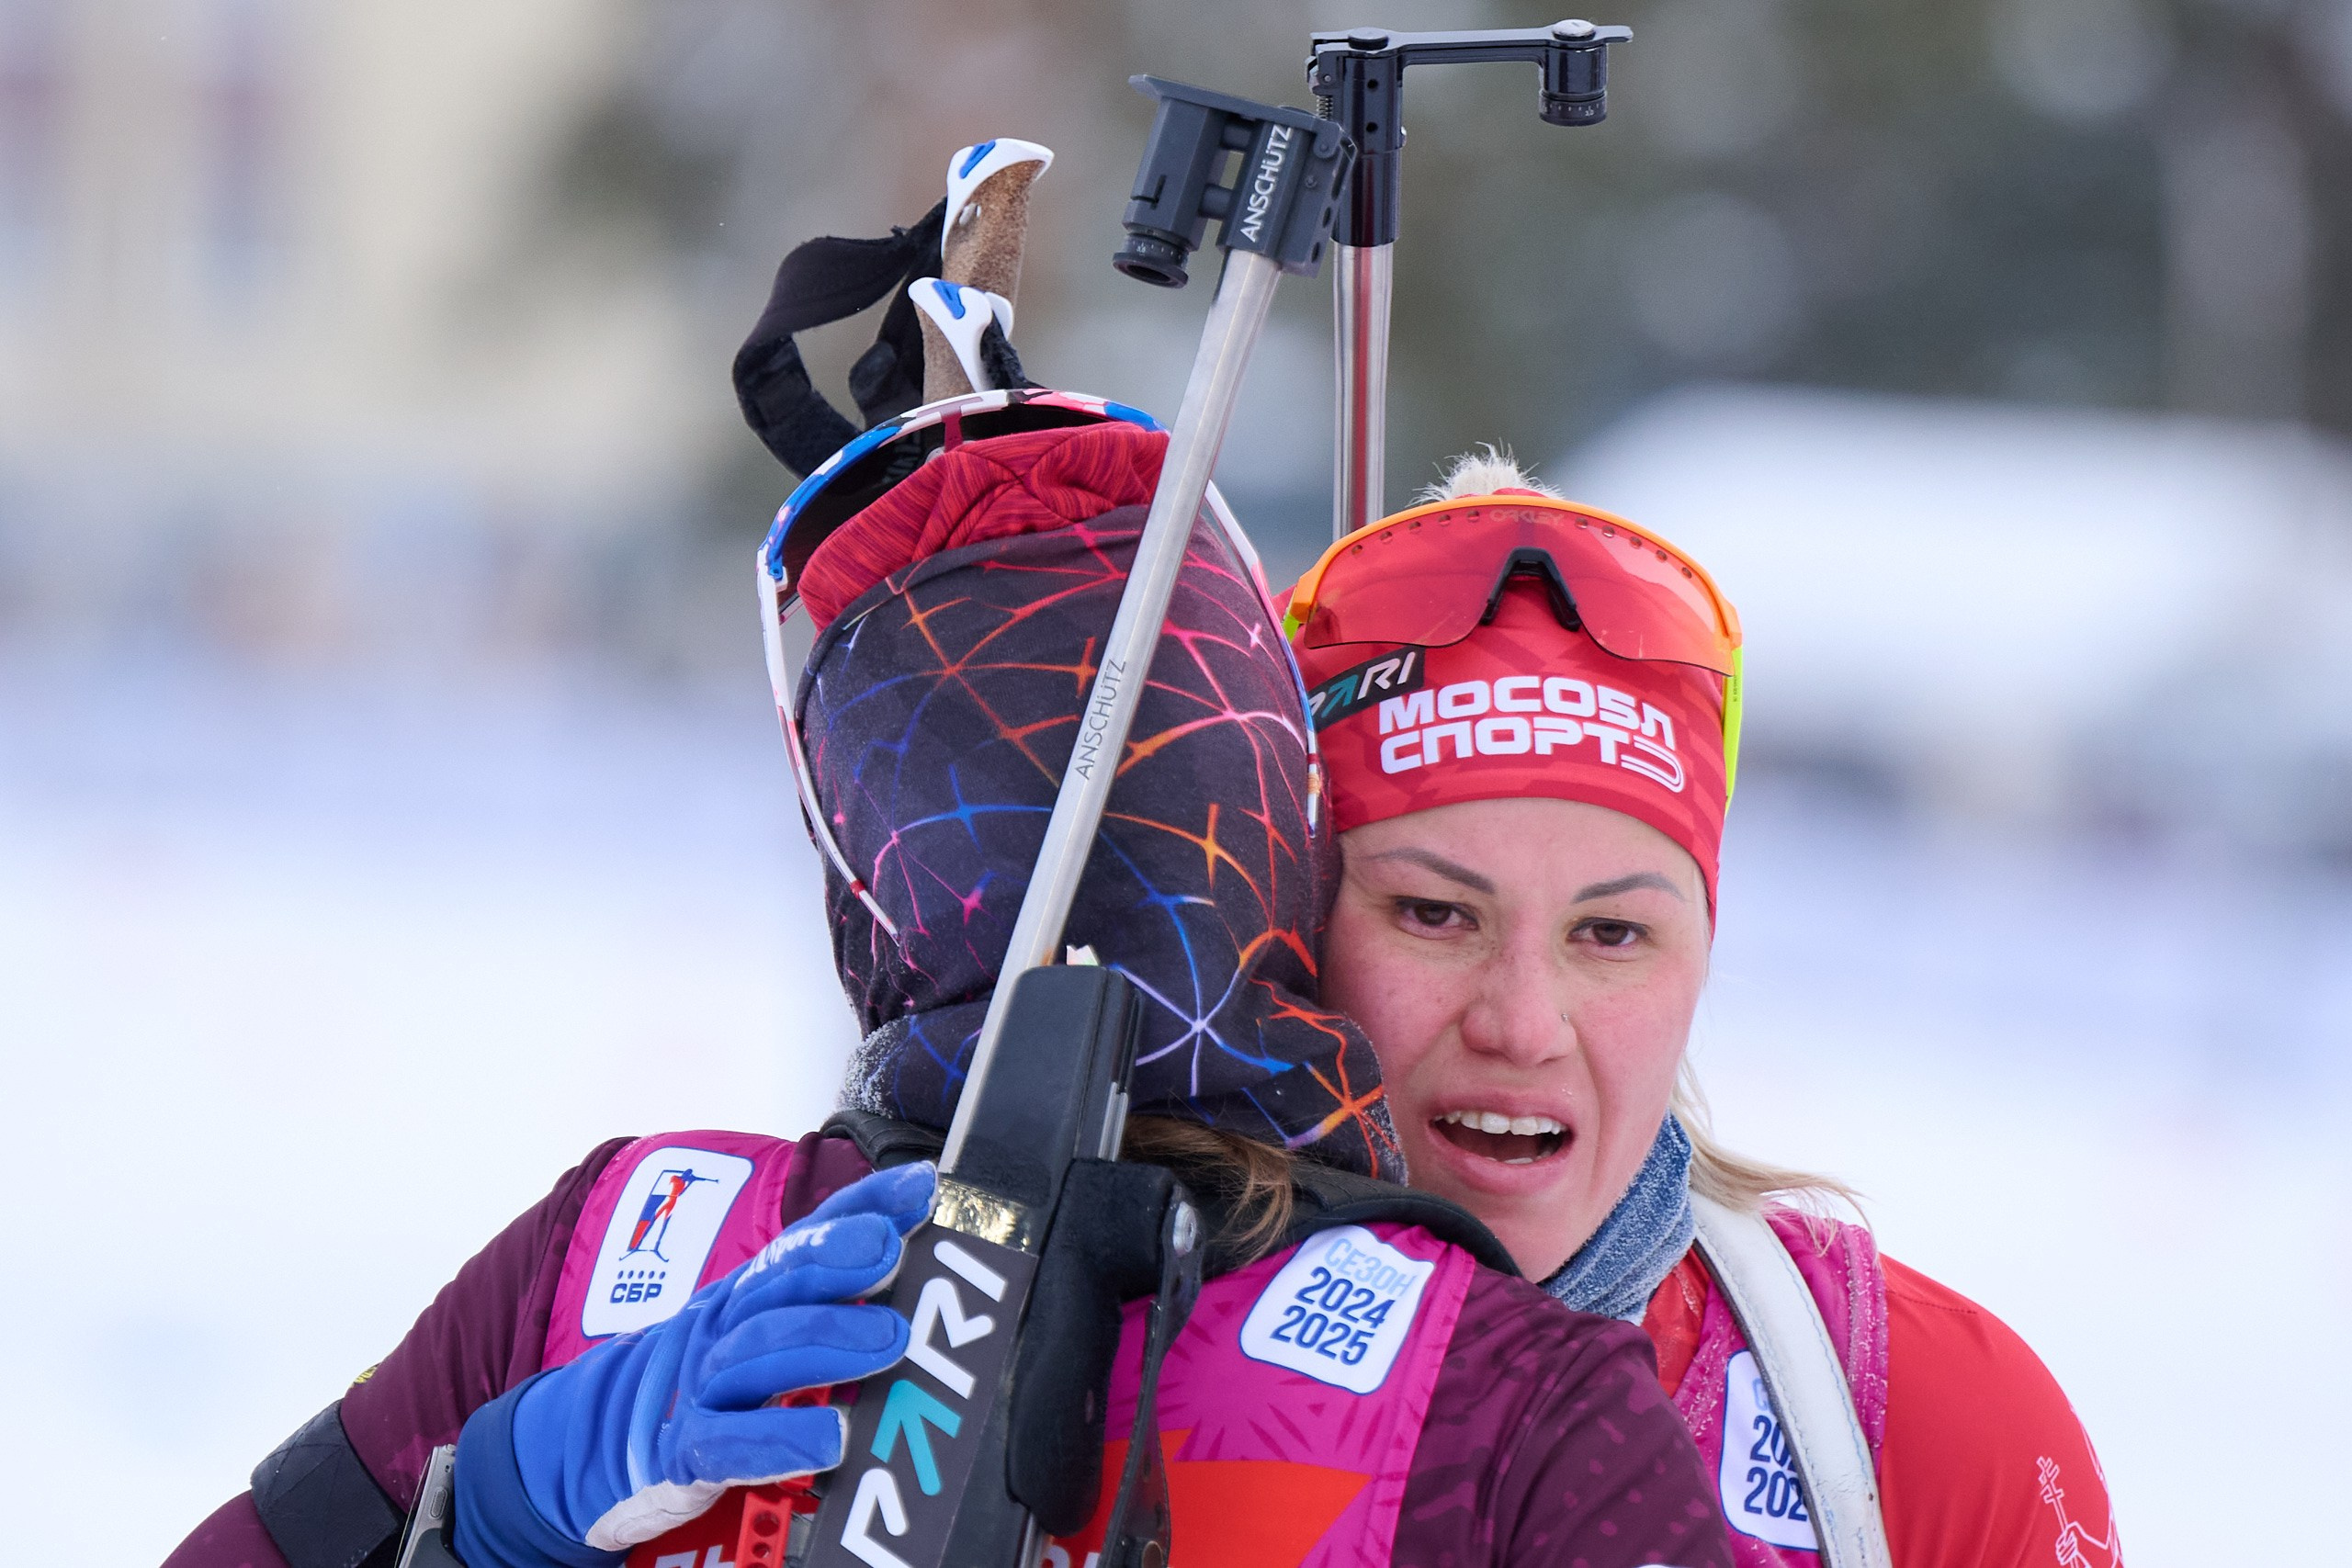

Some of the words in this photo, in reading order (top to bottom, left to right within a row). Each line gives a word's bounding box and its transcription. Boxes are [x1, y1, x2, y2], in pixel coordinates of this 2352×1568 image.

[1239, 123, 1292, 243] ANSCHÜTZ
[1074, 658, 1127, 781] ANSCHÜTZ
[1378, 675, 1677, 752] МОСОБЛ
[1379, 716, 1631, 775] СПОРТ
[609, 1282, 662, 1303] СБР
[1294, 1265, 1396, 1330] 2024
[1324, 1237, 1418, 1297] СЕЗОН
[1269, 1304, 1376, 1367] 2025
[1743, 1466, 1809, 1523] 202
